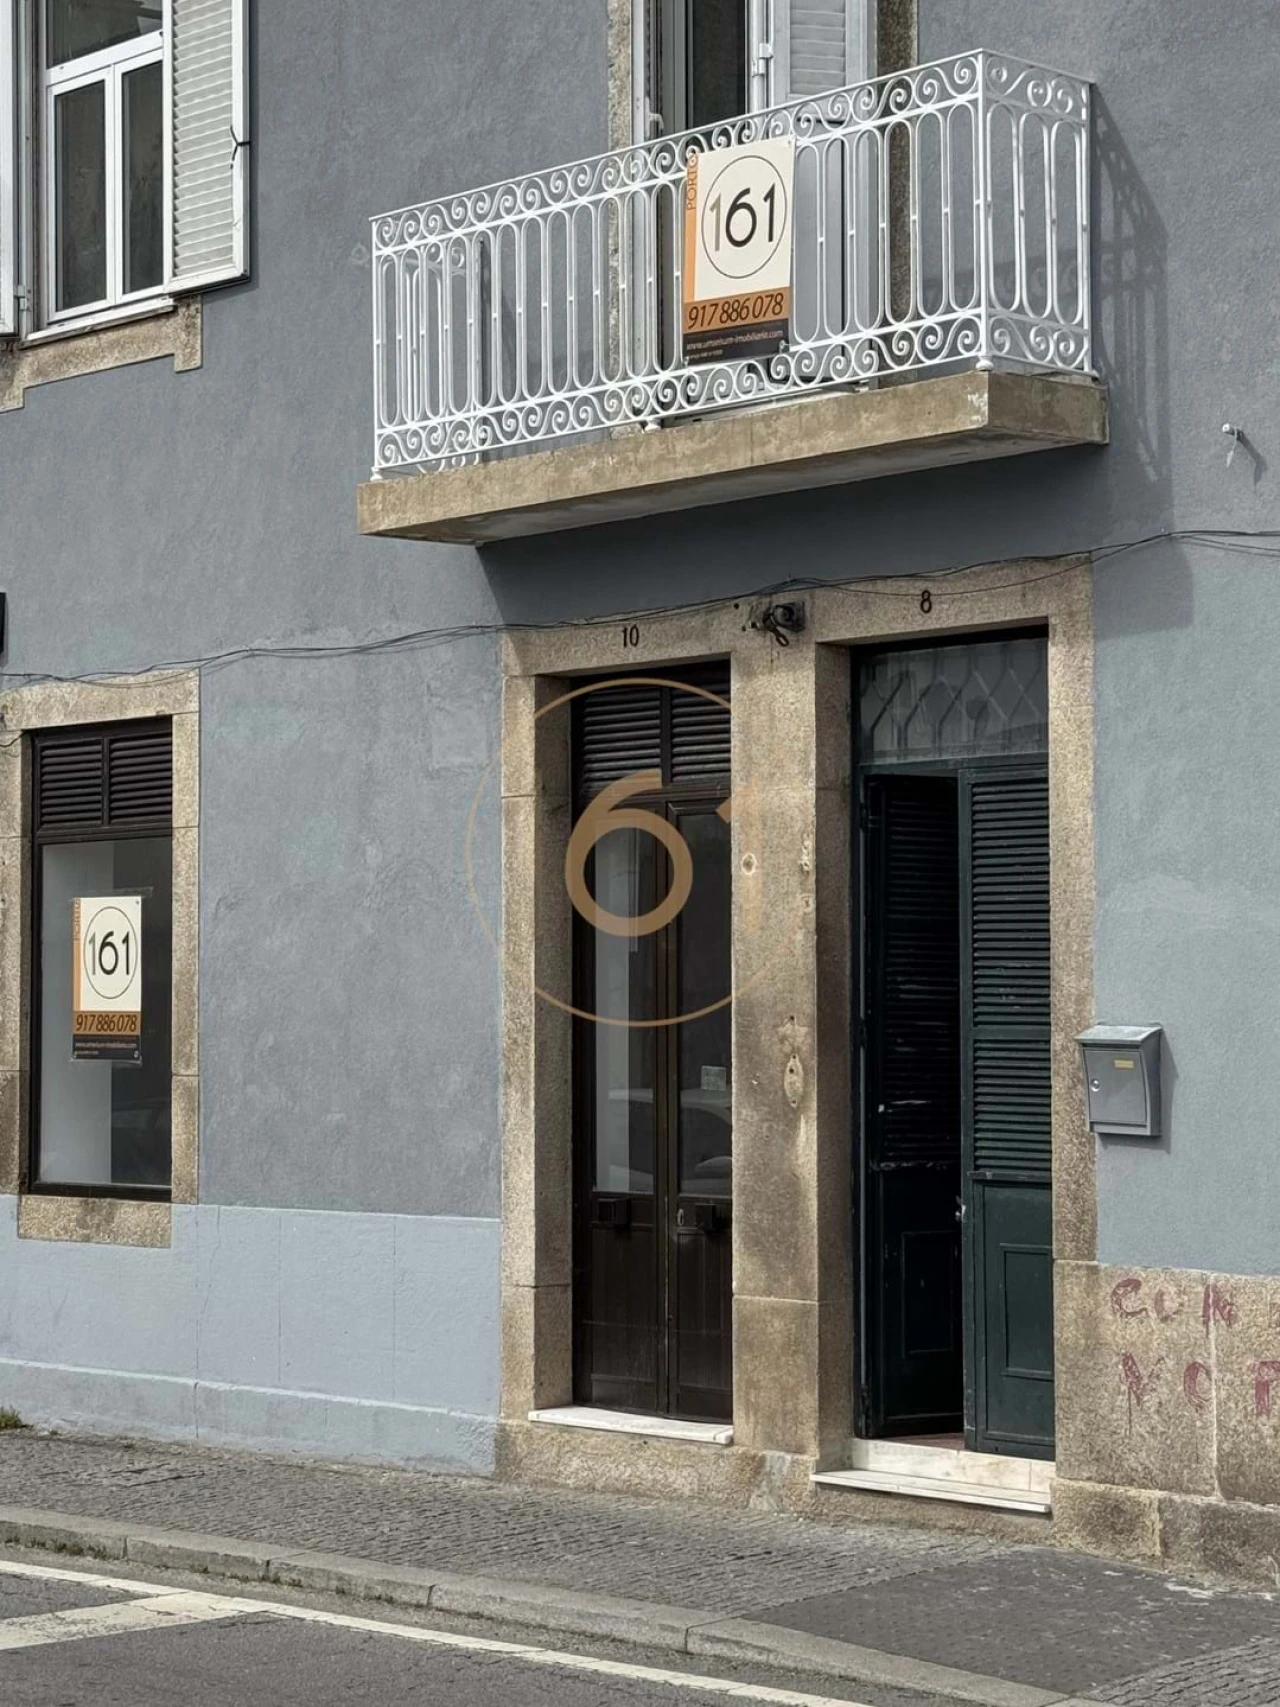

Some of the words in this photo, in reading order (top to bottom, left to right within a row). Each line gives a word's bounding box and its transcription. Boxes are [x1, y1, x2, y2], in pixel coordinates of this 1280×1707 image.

[709, 182, 776, 252] 161
[919, 589, 933, 614] 8
[622, 623, 639, 648] 10
[88, 930, 130, 976] 161
